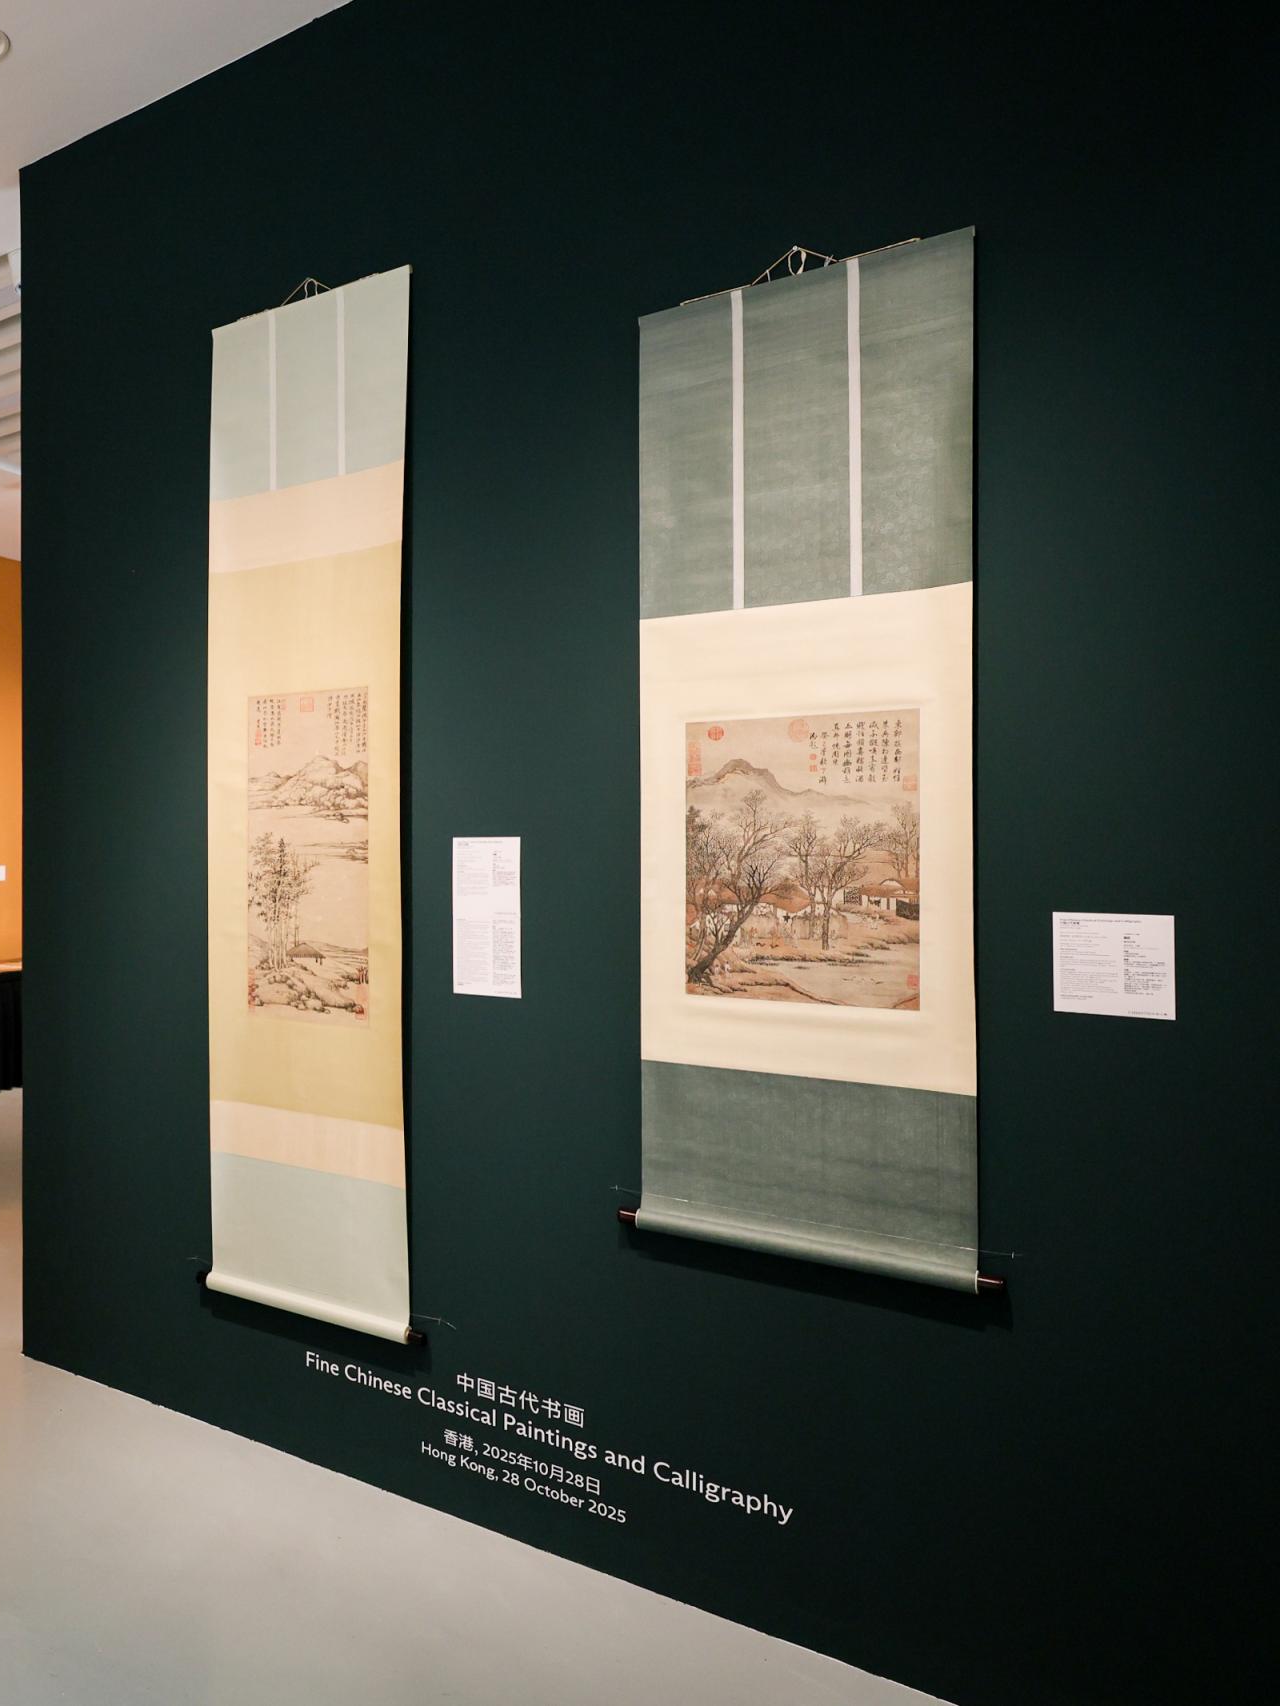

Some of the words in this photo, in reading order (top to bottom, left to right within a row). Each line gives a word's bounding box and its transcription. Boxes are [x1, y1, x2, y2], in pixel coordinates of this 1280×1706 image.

[456, 1372, 585, 1429] 中国古代书画
[305, 1350, 340, 1377] Fine
[344, 1364, 412, 1400] Chinese
[417, 1387, 497, 1427] Classical
[503, 1412, 598, 1461] Paintings
[604, 1450, 646, 1476] and
[653, 1461, 794, 1525] Calligraphy
[482, 1442, 601, 1496] 2025年10月28日
[421, 1441, 457, 1467] Hong
[460, 1454, 499, 1482] Kong,
[502, 1469, 520, 1486] 28
[524, 1477, 585, 1509] October
[588, 1499, 626, 1523] 2025
